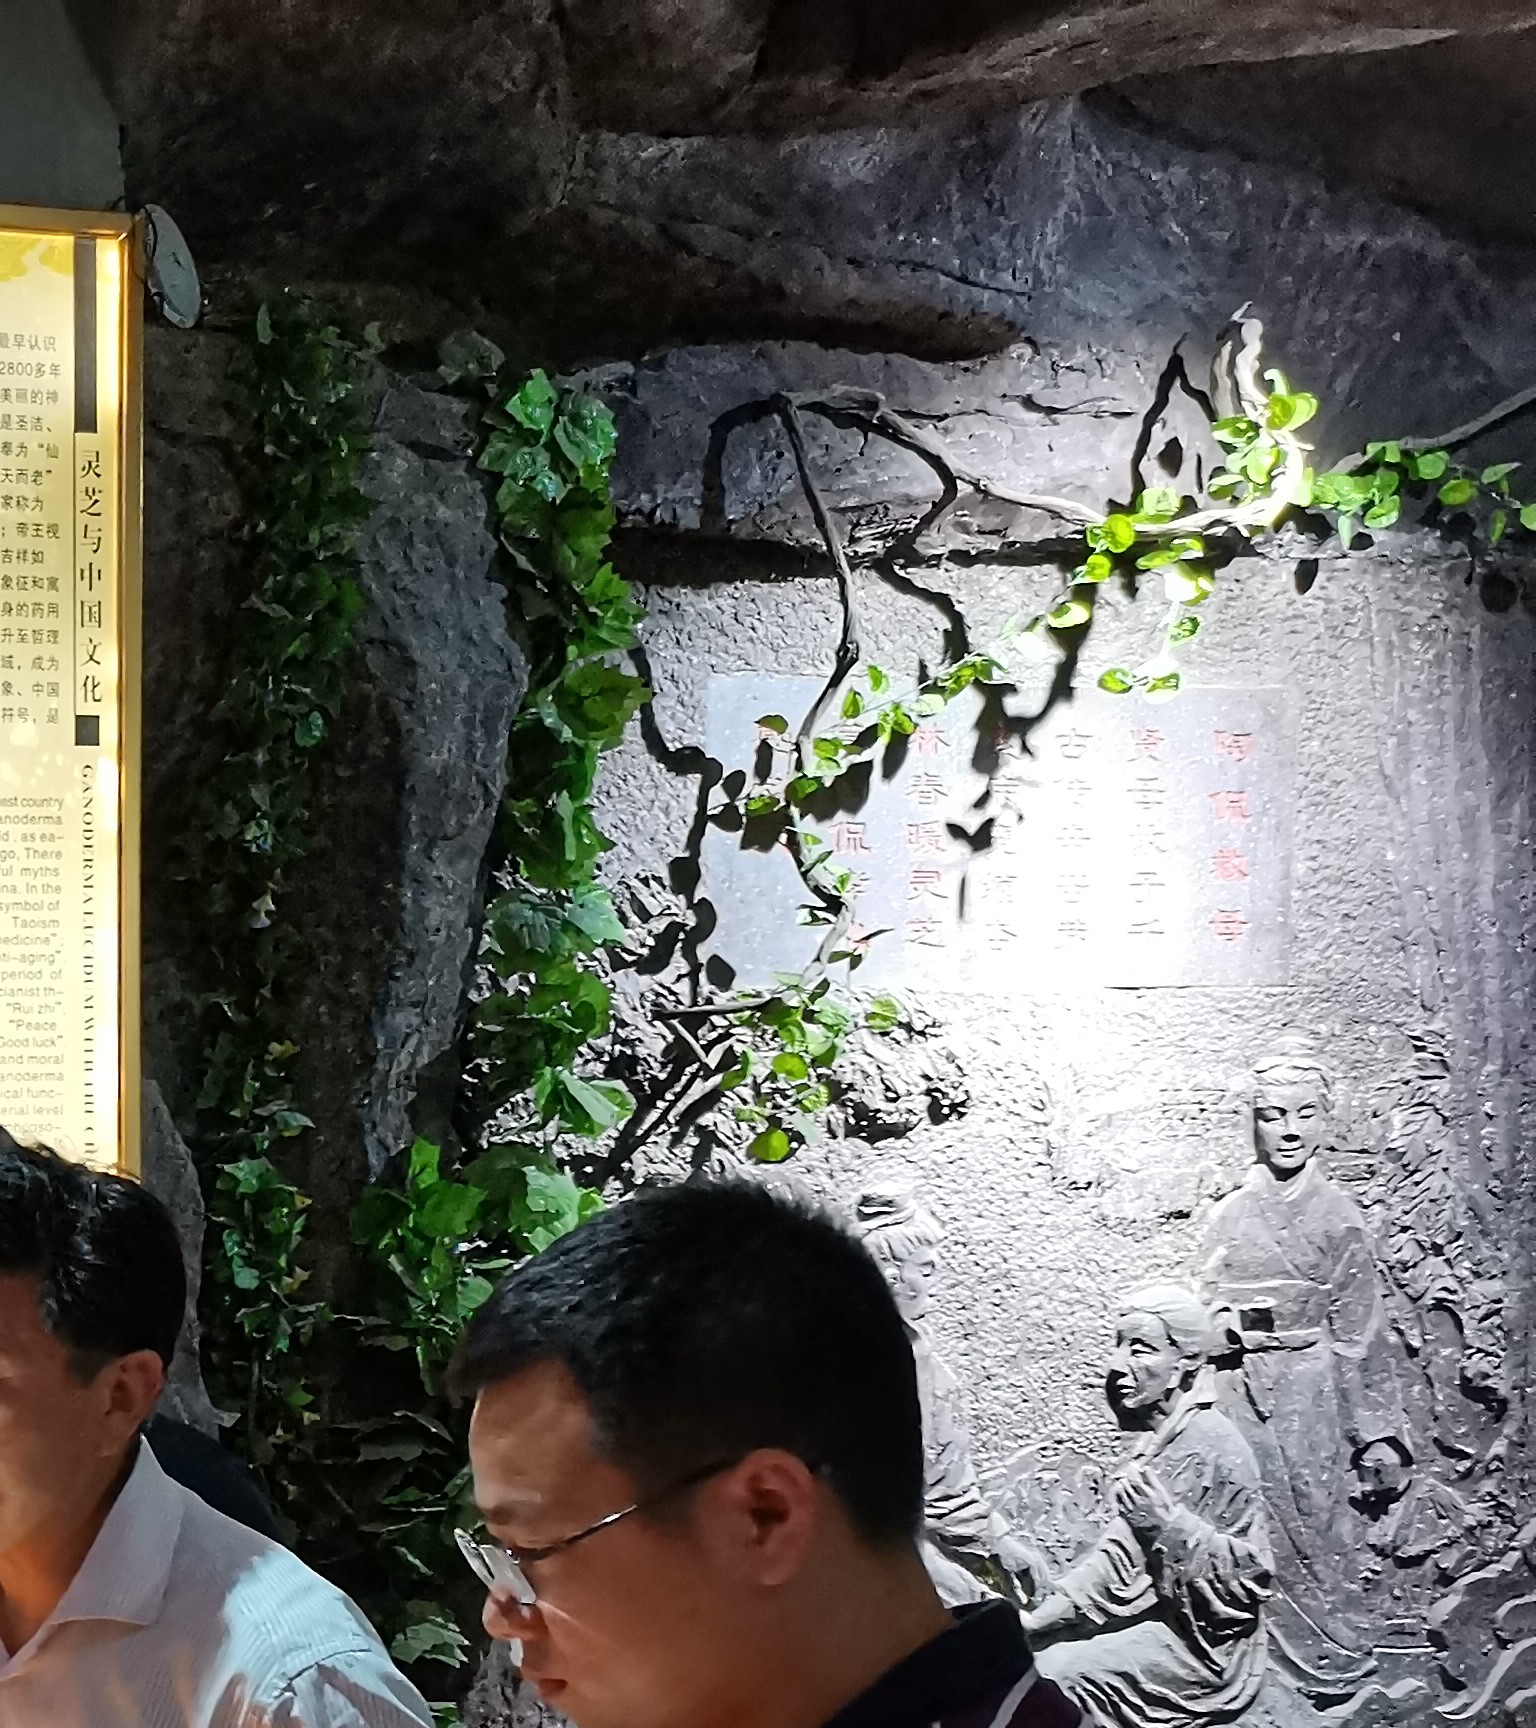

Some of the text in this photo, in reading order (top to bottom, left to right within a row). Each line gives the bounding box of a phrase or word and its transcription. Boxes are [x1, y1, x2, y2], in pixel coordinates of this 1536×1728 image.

[79, 449, 103, 704] 灵芝与中国文化
[20, 798, 64, 811] country
[20, 833, 36, 842] as
[24, 847, 62, 860] There
[20, 866, 60, 880] myths
[41, 883, 62, 894] the
[47, 900, 60, 912] of
[11, 916, 60, 929] Taoism
[1, 969, 43, 983] period
[50, 968, 62, 980] of
[0, 1054, 23, 1064] and
[27, 1054, 64, 1064] moral
